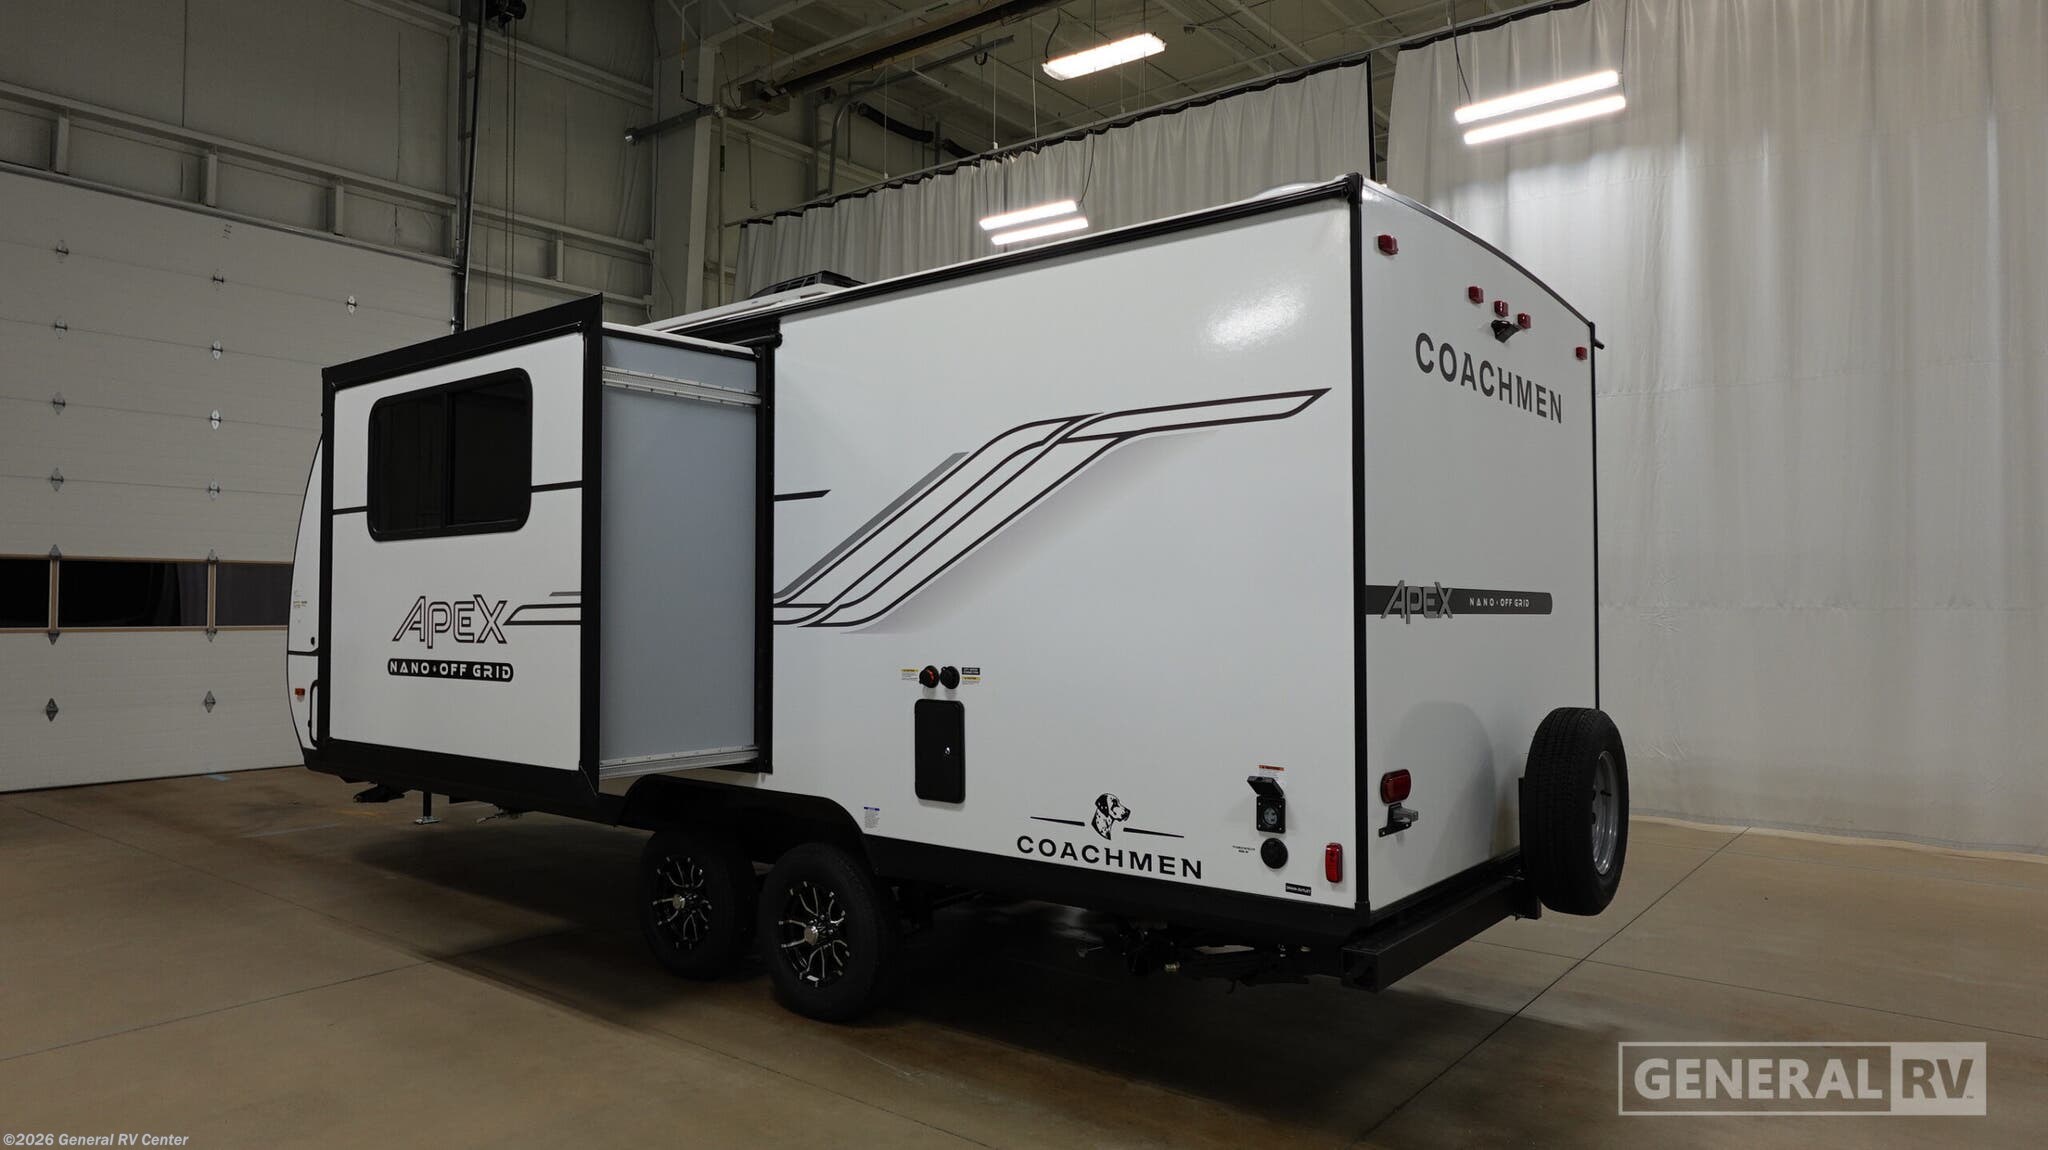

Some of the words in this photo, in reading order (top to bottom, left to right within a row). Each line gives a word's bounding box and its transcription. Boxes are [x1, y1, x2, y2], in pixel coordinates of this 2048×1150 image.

[1415, 332, 1562, 424] COACHMEN
[392, 594, 507, 649] APEX
[1380, 580, 1453, 624] APEX
[1469, 597, 1495, 606] NANO
[1500, 599, 1512, 607] OFF
[1514, 600, 1530, 608] GRID
[389, 660, 430, 675] NANO
[439, 663, 467, 677] OFF
[472, 665, 511, 680] GRID
[1017, 835, 1201, 879] COACHMEN
